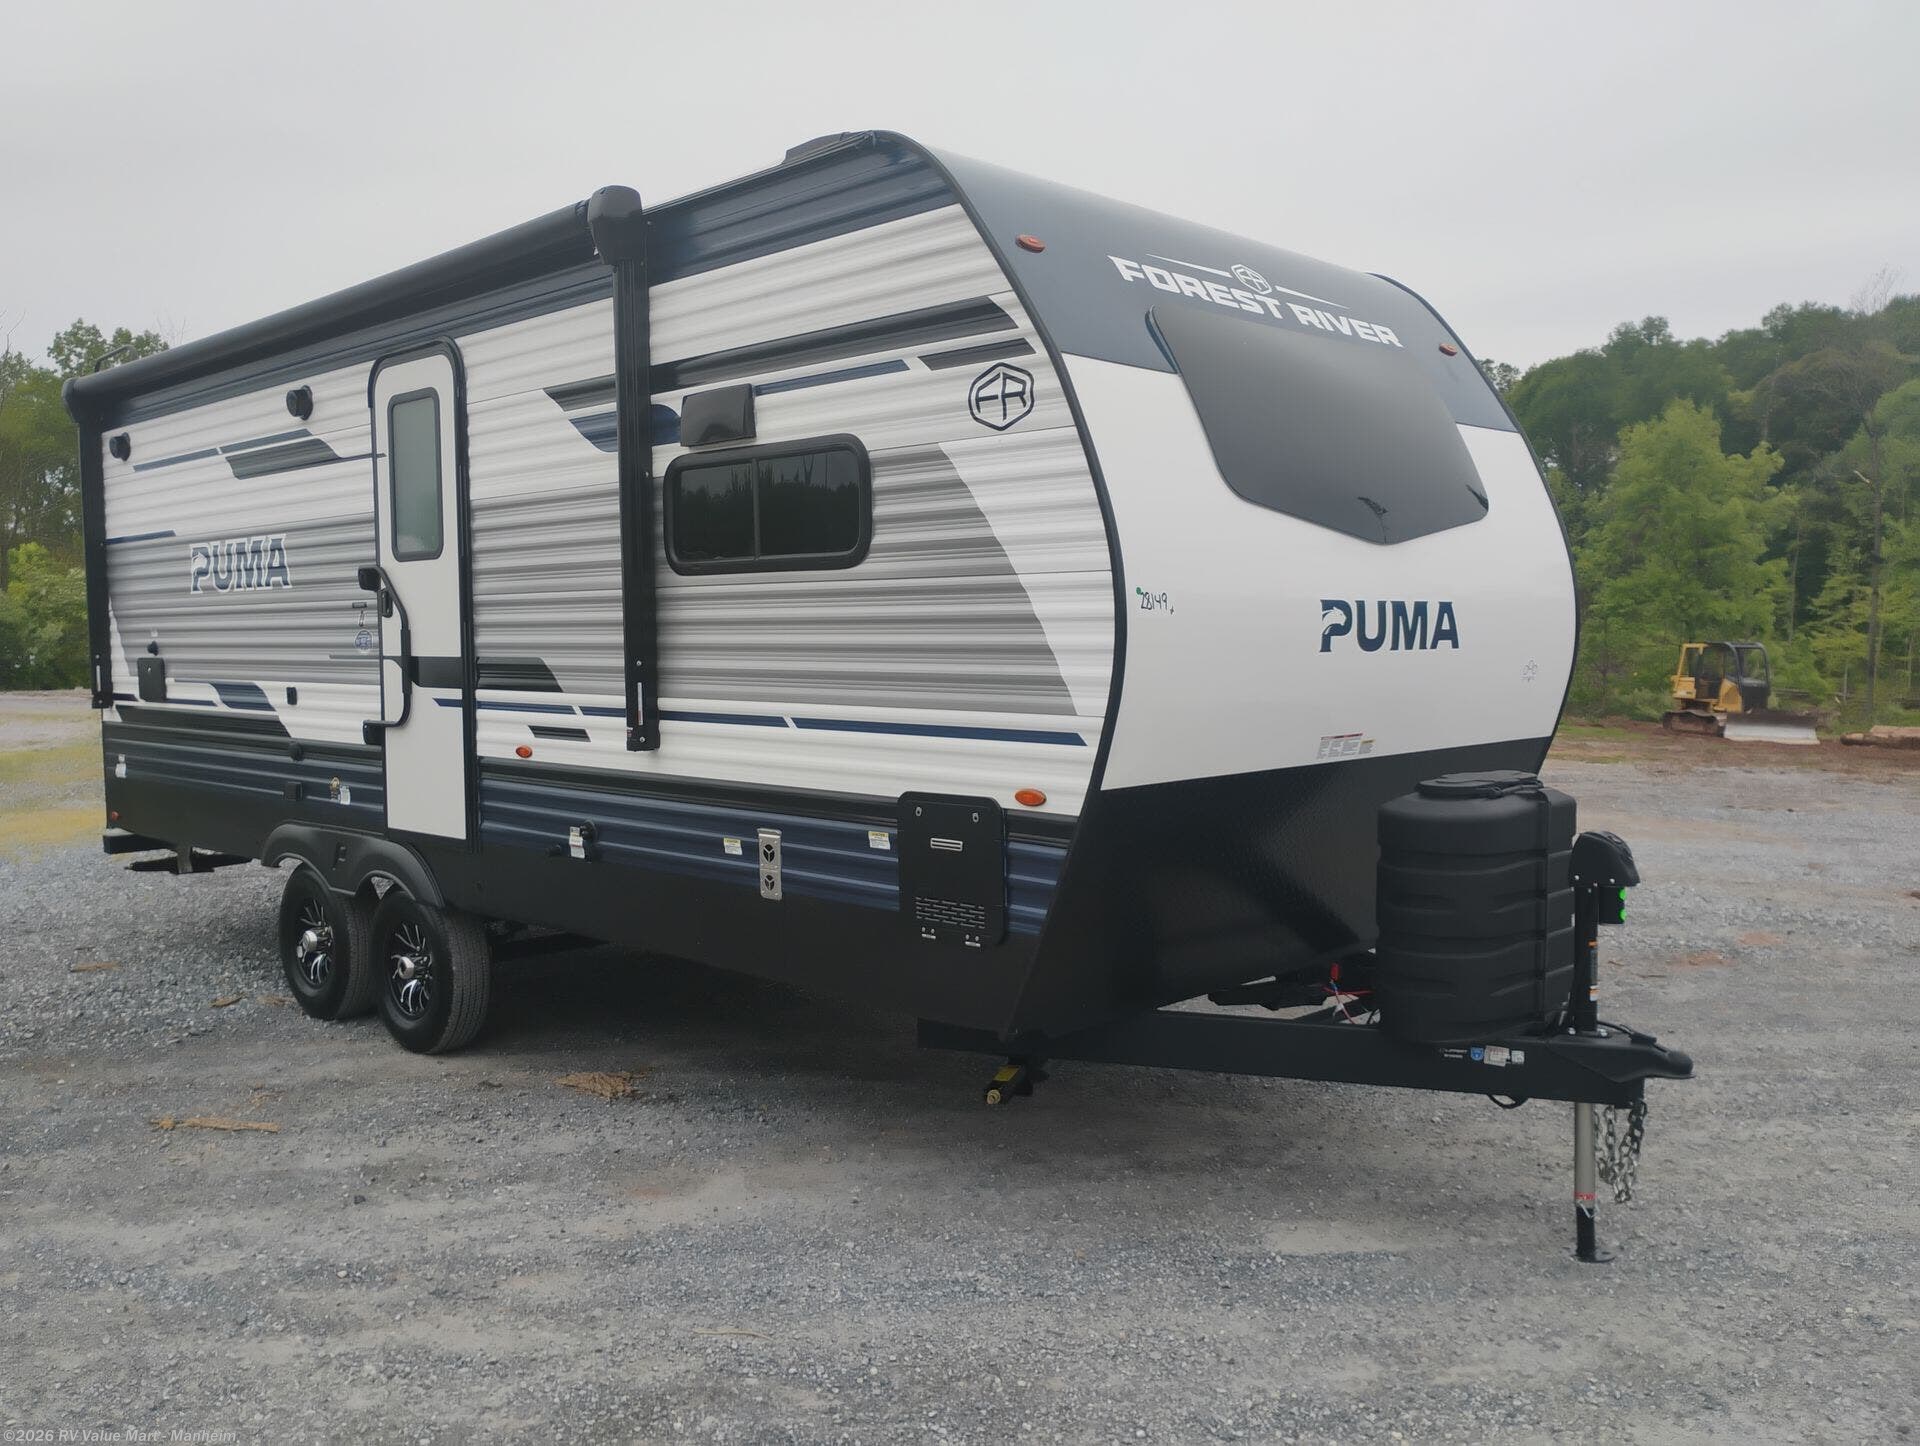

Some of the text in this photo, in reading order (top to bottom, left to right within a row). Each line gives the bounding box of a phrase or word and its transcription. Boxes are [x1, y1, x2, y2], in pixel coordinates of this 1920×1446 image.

[1107, 254, 1404, 348] FOREST RIVER
[190, 534, 292, 594] PUMA
[1319, 599, 1459, 652] PUMA
